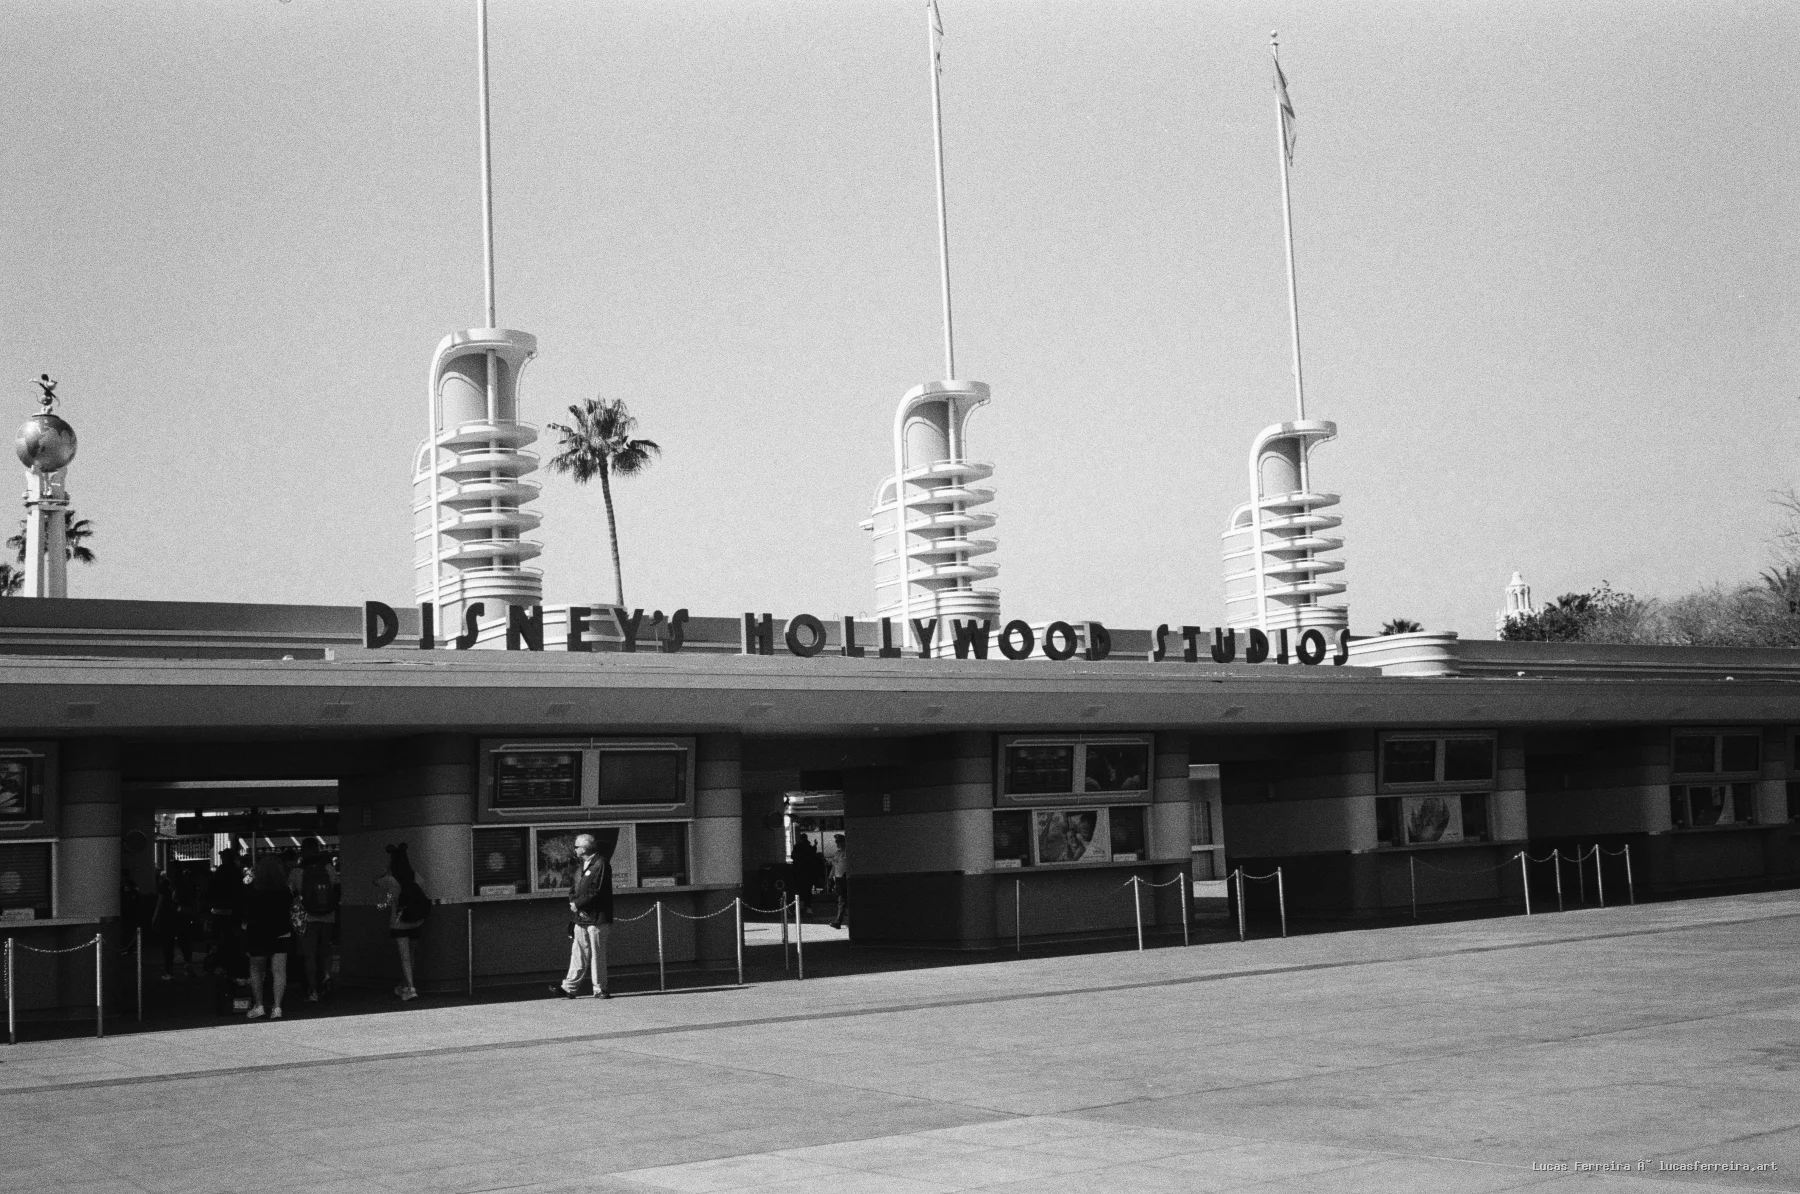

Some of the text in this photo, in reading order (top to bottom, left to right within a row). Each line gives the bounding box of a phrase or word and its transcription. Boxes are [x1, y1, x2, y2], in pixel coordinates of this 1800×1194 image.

[363, 600, 1351, 666] DISNEY'S HOLLYWOOD STUDIOS
